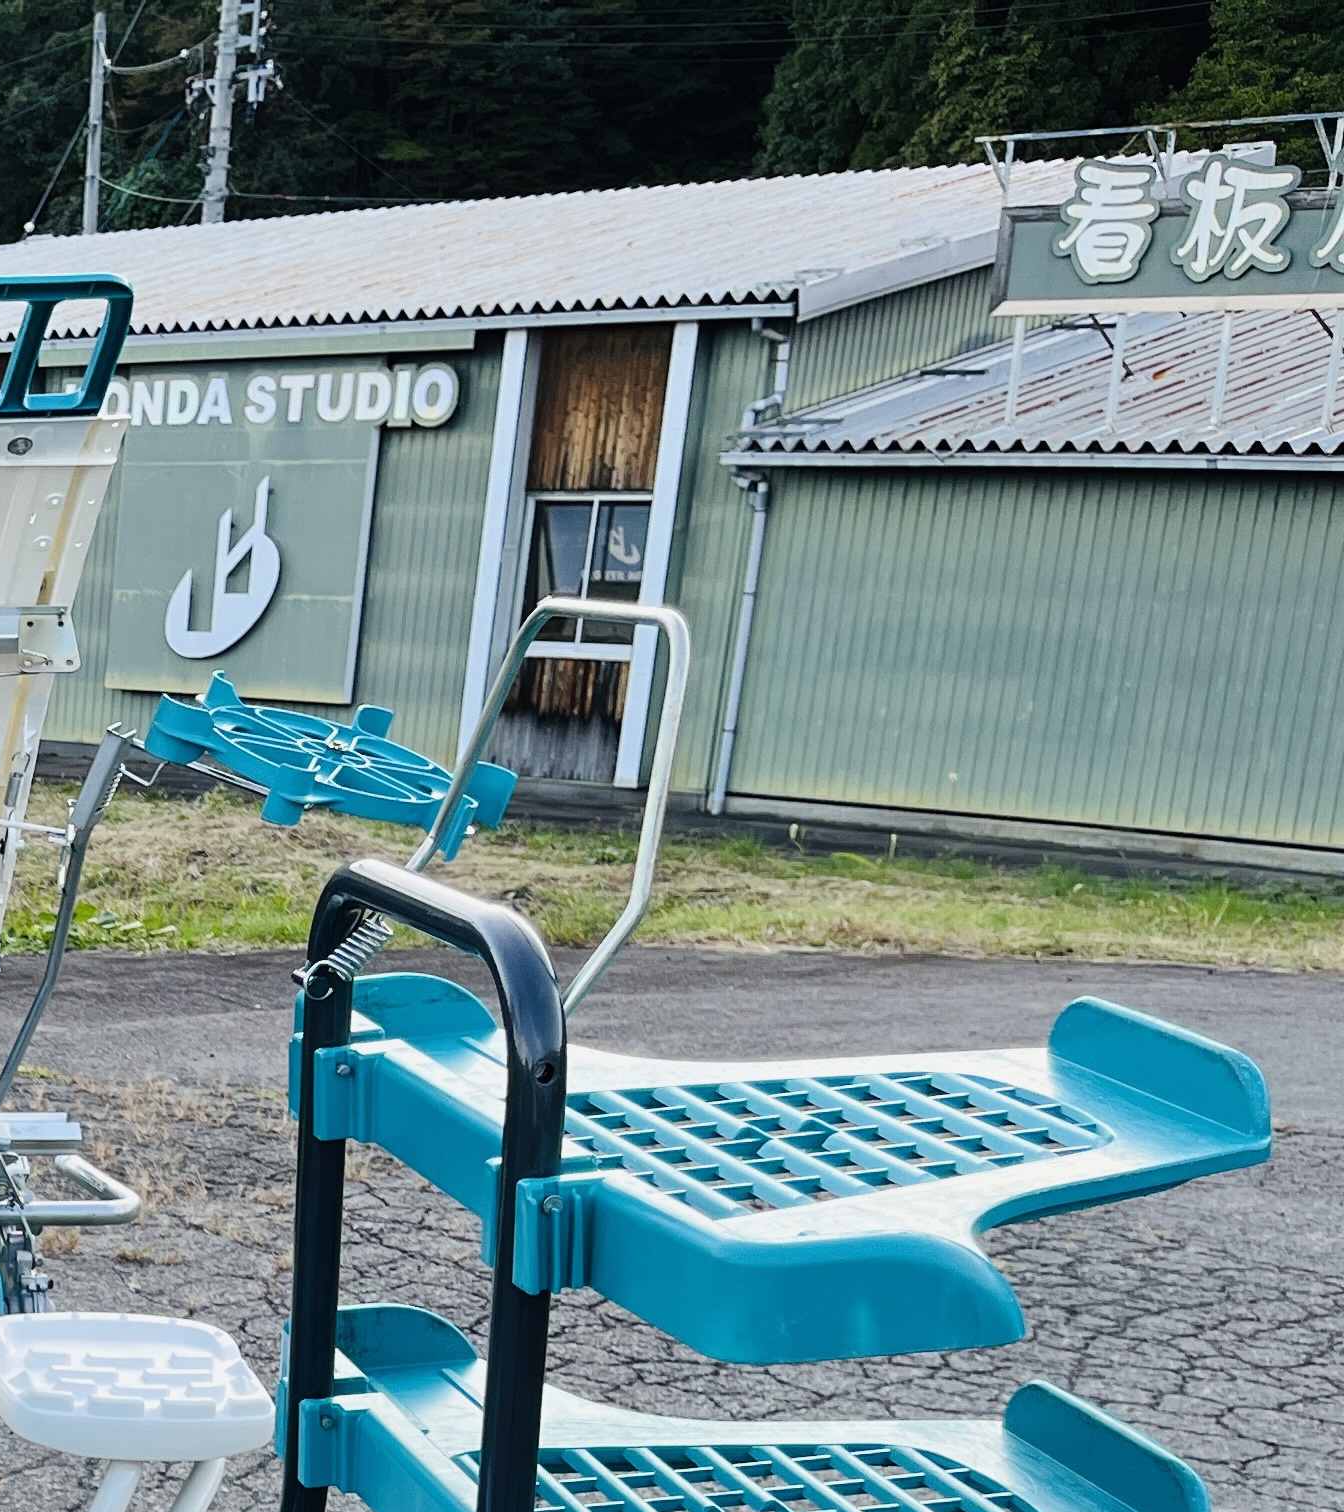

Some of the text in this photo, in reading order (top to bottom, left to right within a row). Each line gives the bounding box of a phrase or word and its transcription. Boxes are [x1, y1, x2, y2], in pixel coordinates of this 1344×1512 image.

[1059, 160, 1344, 276] 看板
[64, 367, 457, 426] ONDA STUDIO
